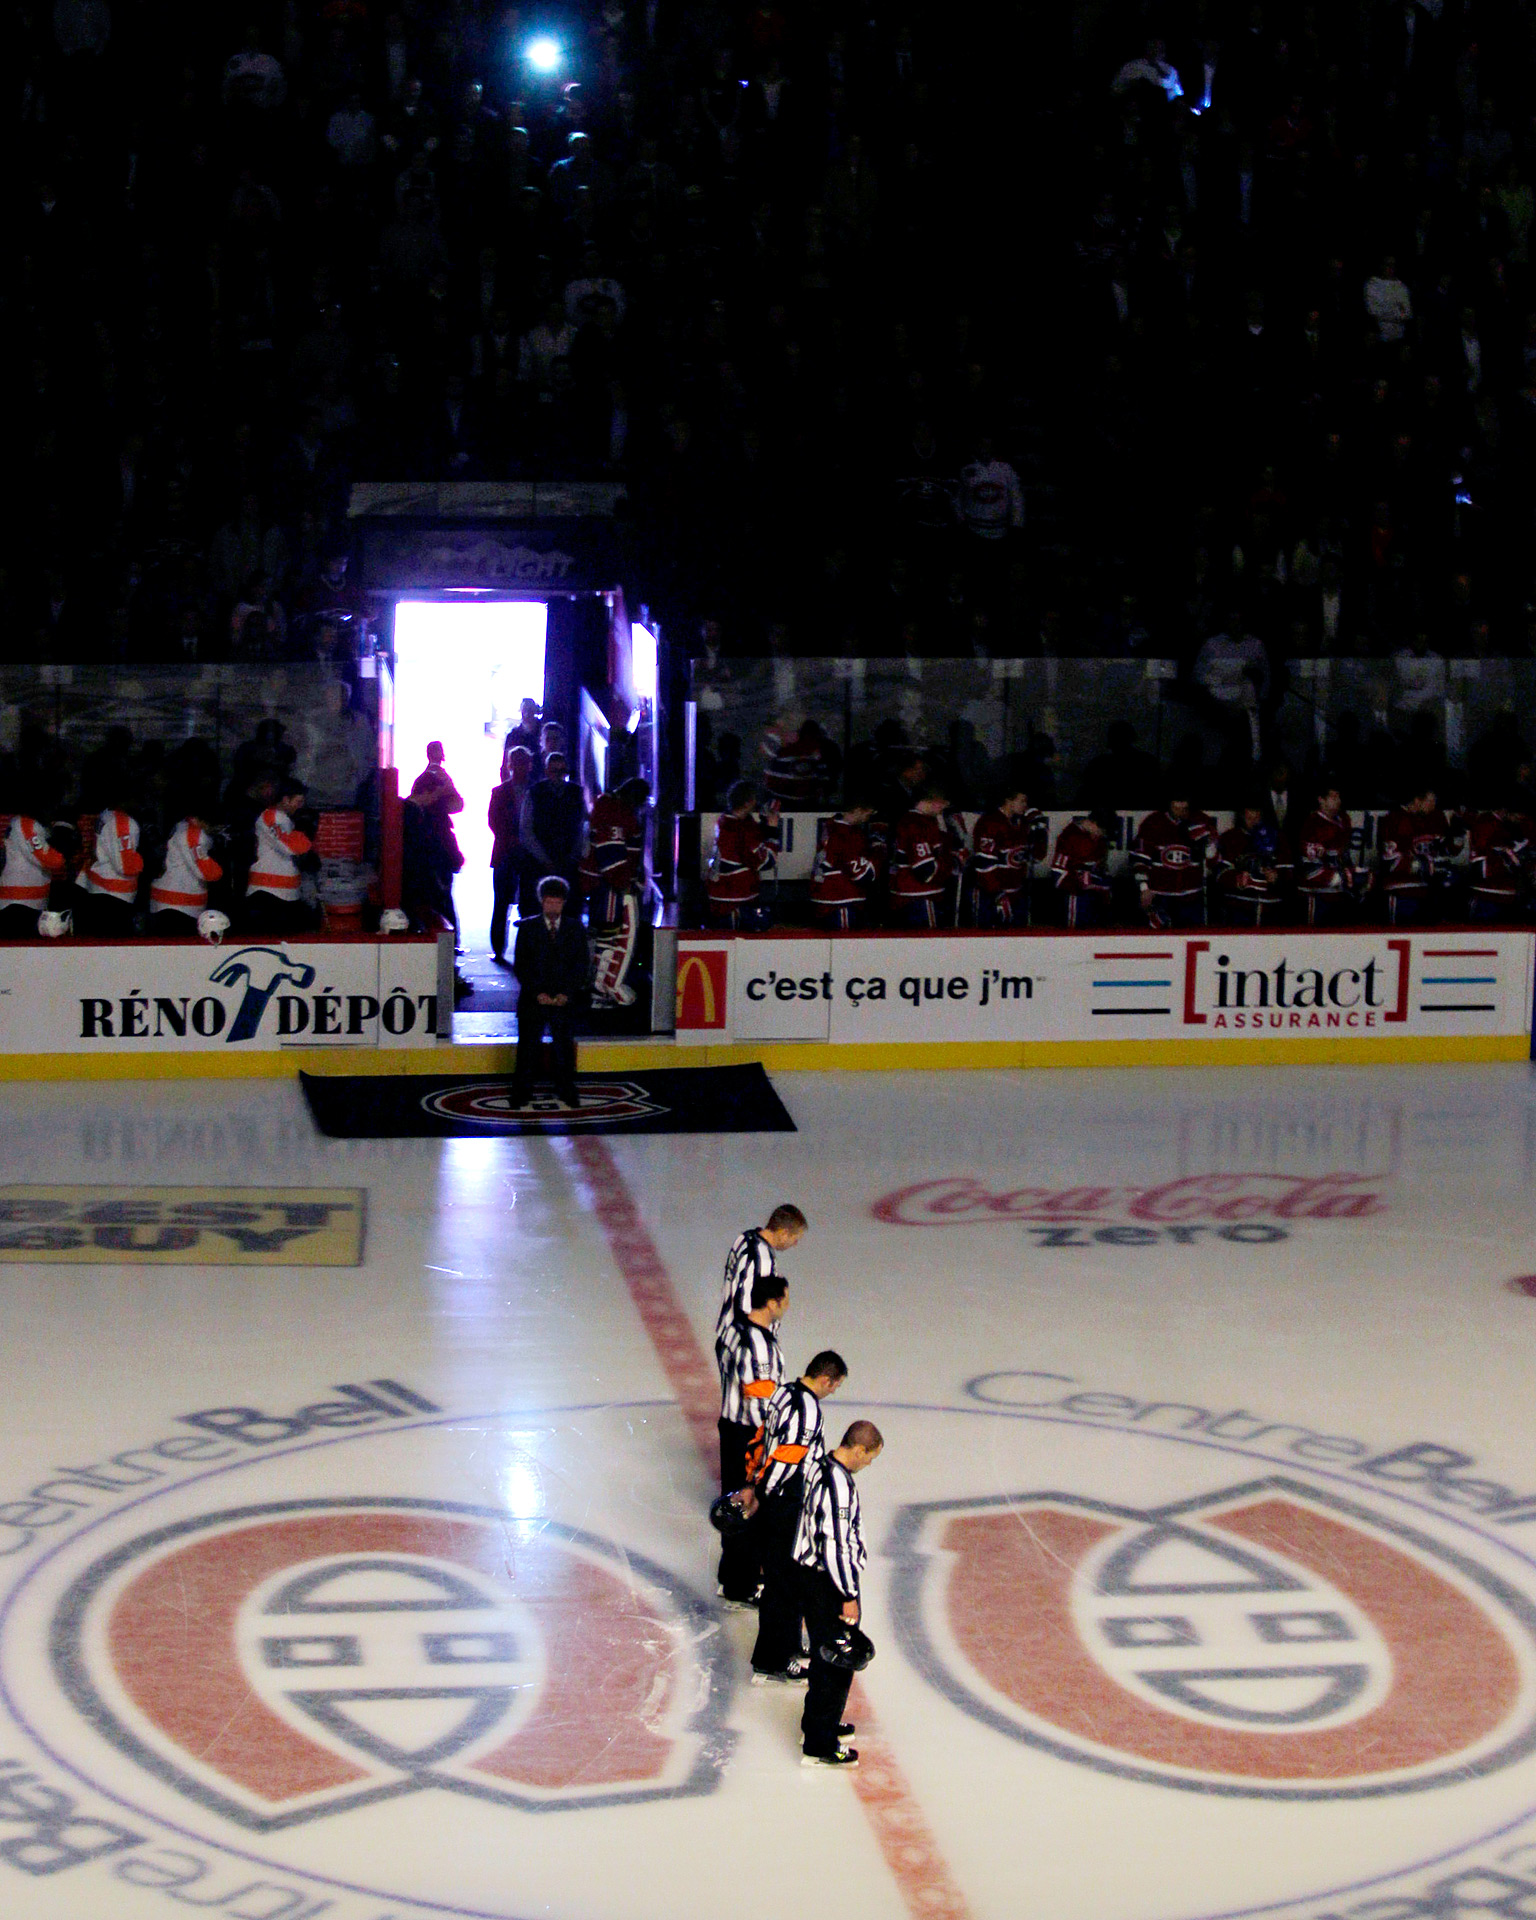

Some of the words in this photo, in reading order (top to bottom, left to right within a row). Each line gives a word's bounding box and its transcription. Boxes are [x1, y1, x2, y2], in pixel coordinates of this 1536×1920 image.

[746, 971, 834, 1001] c'est
[845, 974, 887, 1007] ça
[899, 974, 970, 1007] que
[979, 969, 1034, 1006] j'm
[1213, 954, 1385, 1009] intact
[79, 989, 227, 1038] RÉNO
[1214, 1011, 1376, 1029] ASSURANCE
[0, 1199, 353, 1229] BEST
[0, 1226, 325, 1252] BUY
[1026, 1222, 1290, 1247] zero
